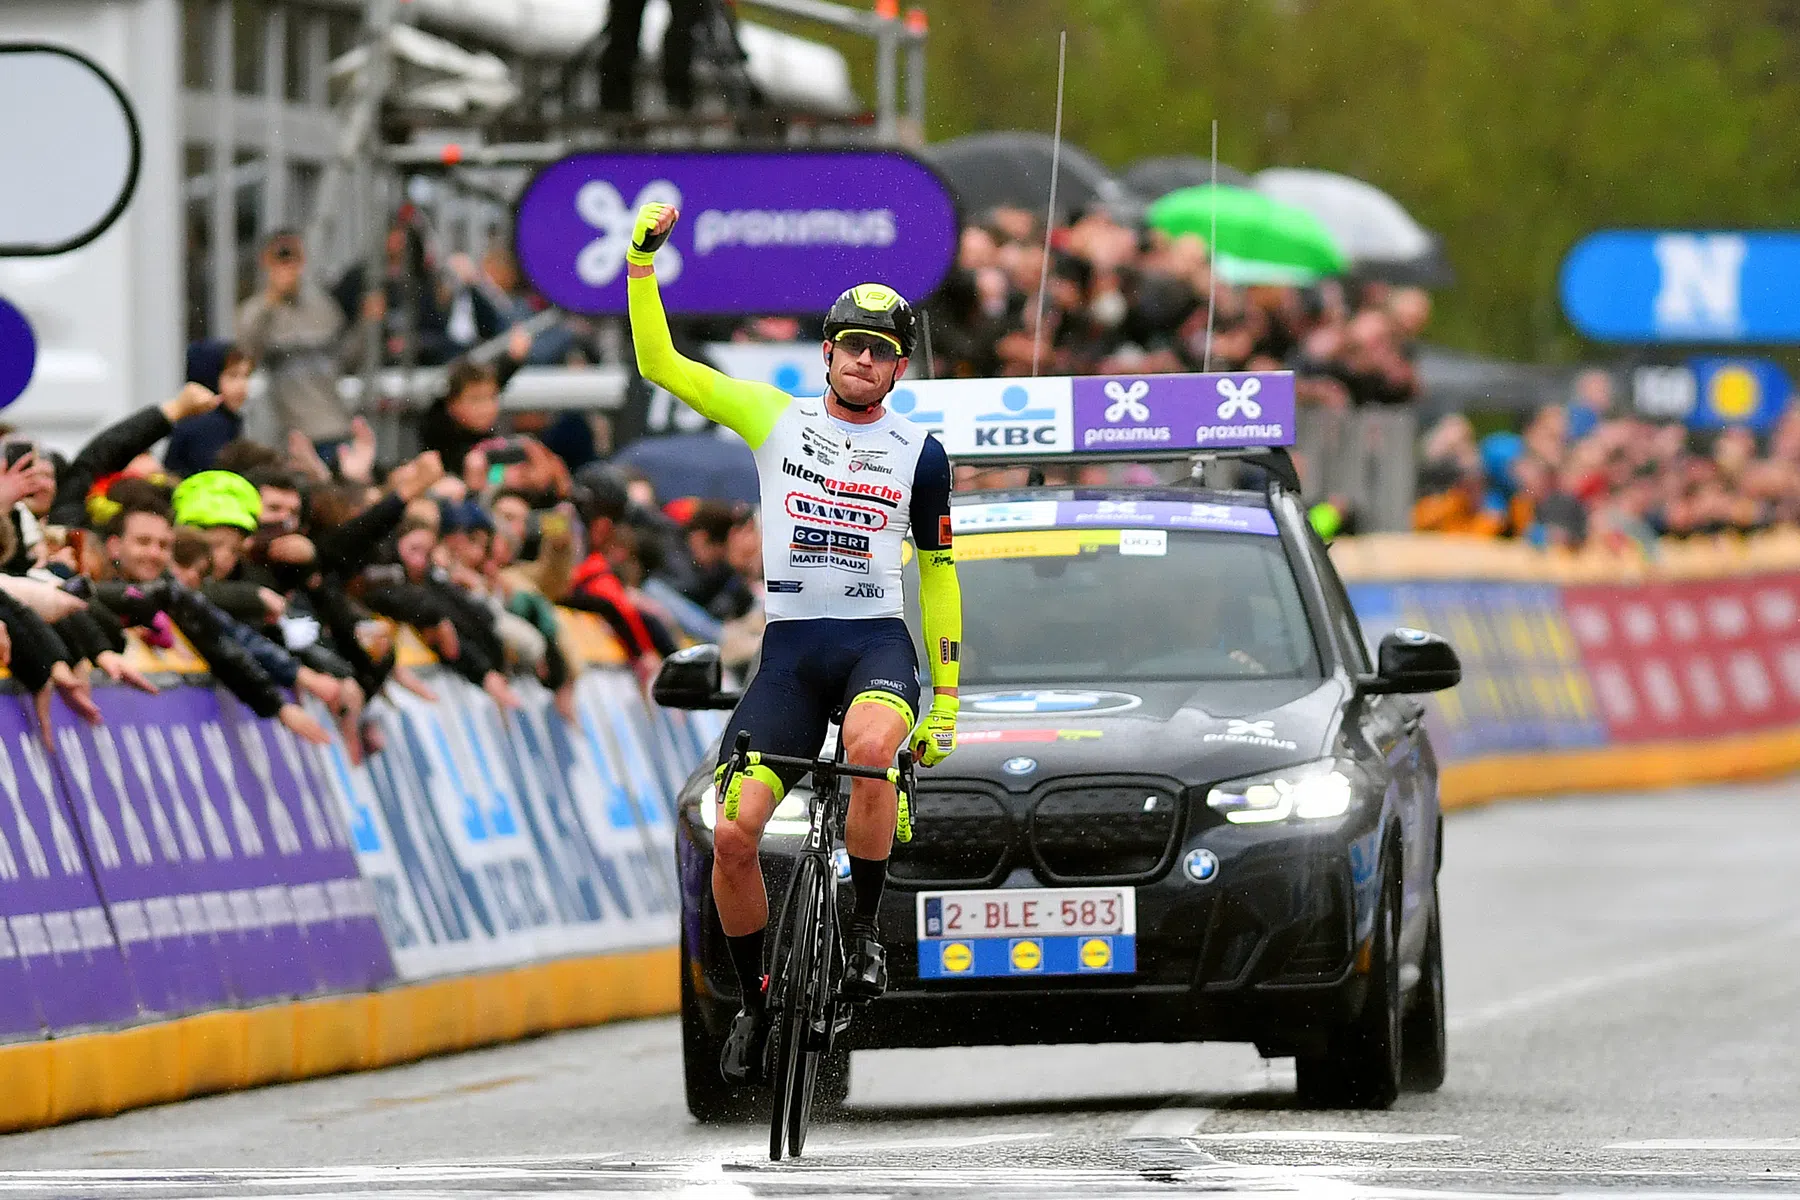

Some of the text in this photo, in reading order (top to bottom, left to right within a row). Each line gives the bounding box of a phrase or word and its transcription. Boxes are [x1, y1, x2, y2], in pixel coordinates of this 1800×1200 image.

[695, 208, 897, 255] proximus
[975, 427, 1056, 447] KBC
[1084, 425, 1171, 446] proximus
[1196, 423, 1283, 444] proximus
[863, 462, 893, 474] Nalini
[795, 499, 876, 525] WANTY
[795, 530, 867, 549] GOBERT
[792, 553, 866, 571] MATERIAUX
[1203, 733, 1297, 750] proximus
[812, 802, 825, 849] CUBE
